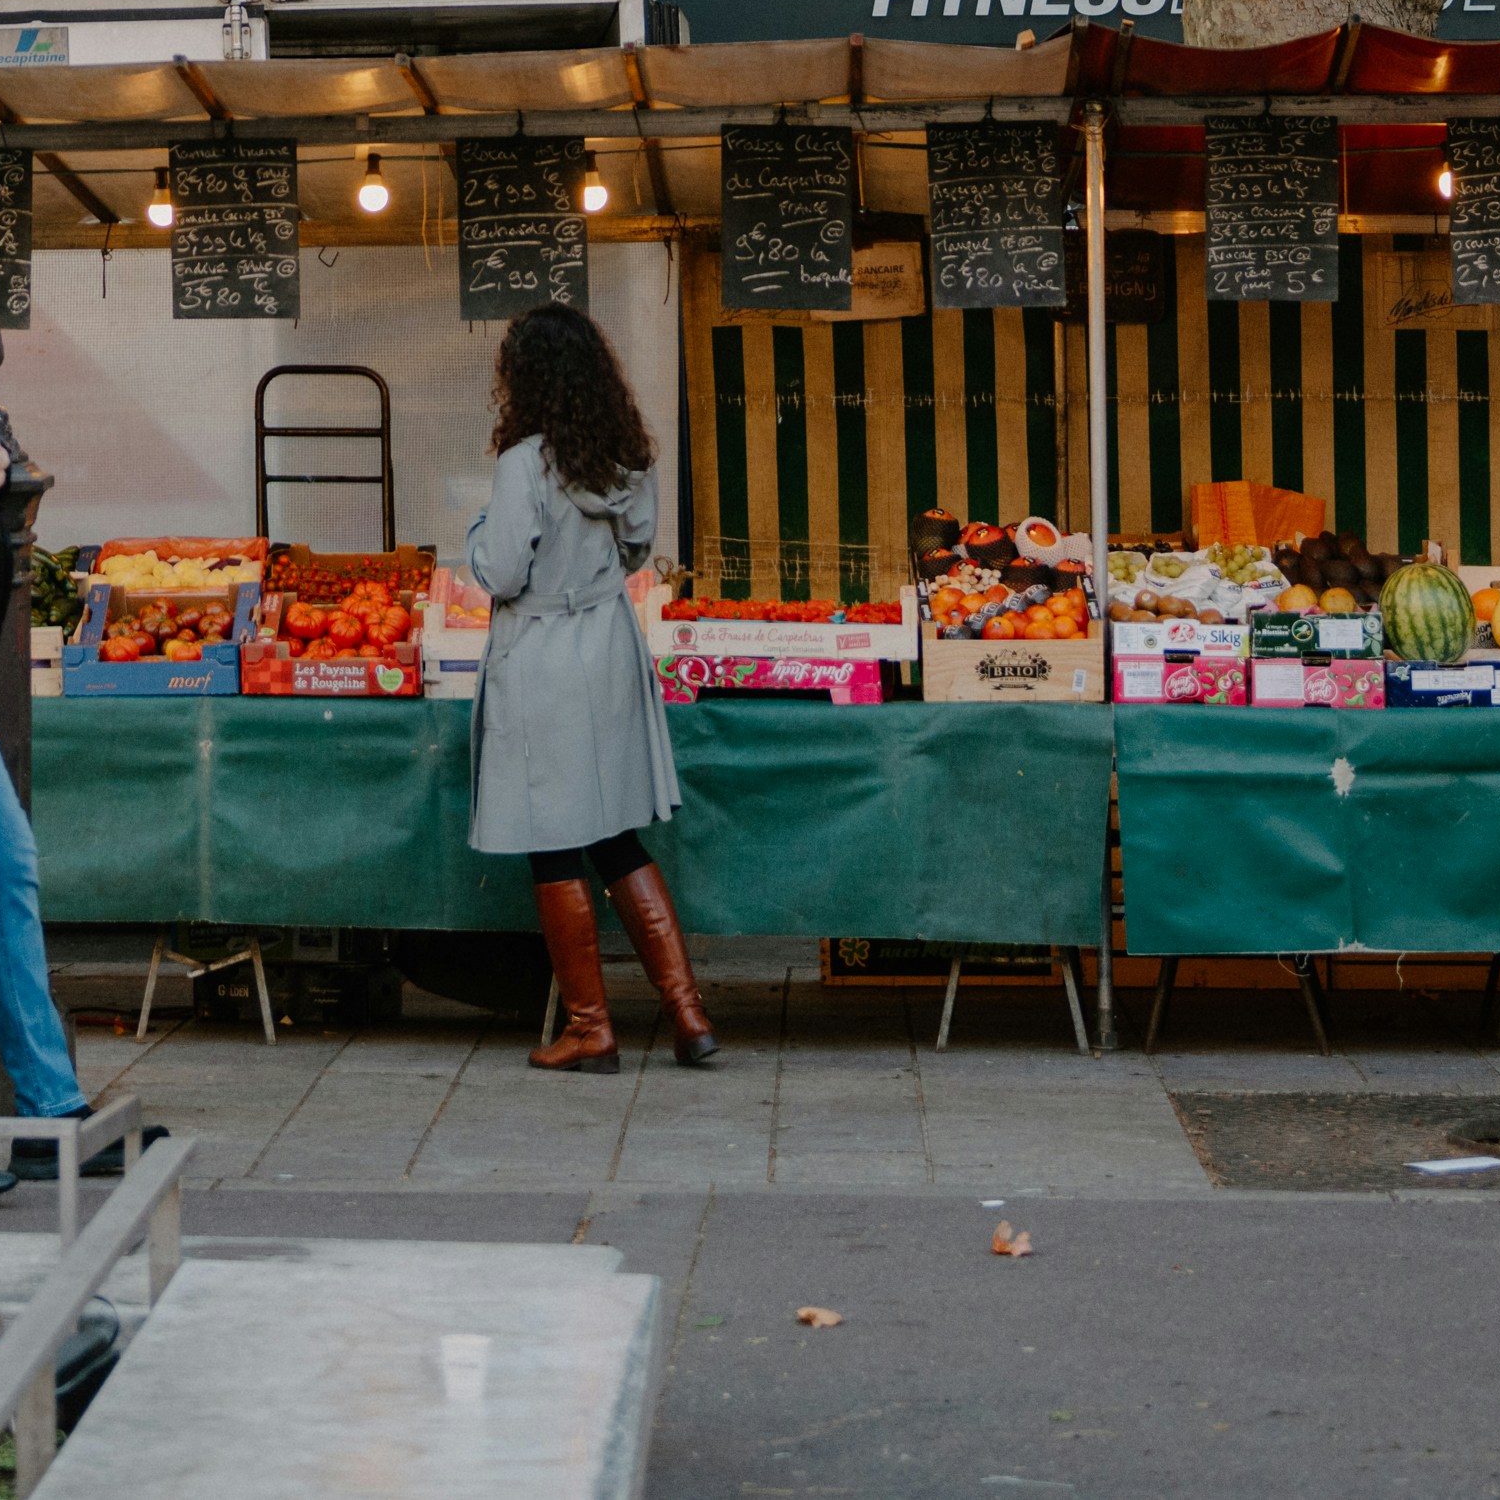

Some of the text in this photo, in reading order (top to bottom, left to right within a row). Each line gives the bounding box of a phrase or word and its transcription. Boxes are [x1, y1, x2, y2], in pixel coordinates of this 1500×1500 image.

[1213, 271, 1232, 294] 2
[1196, 629, 1241, 647] by Sikig
[295, 663, 366, 677] Les Paysans
[993, 666, 1034, 676] BRIO
[295, 676, 367, 691] de Rougeline
